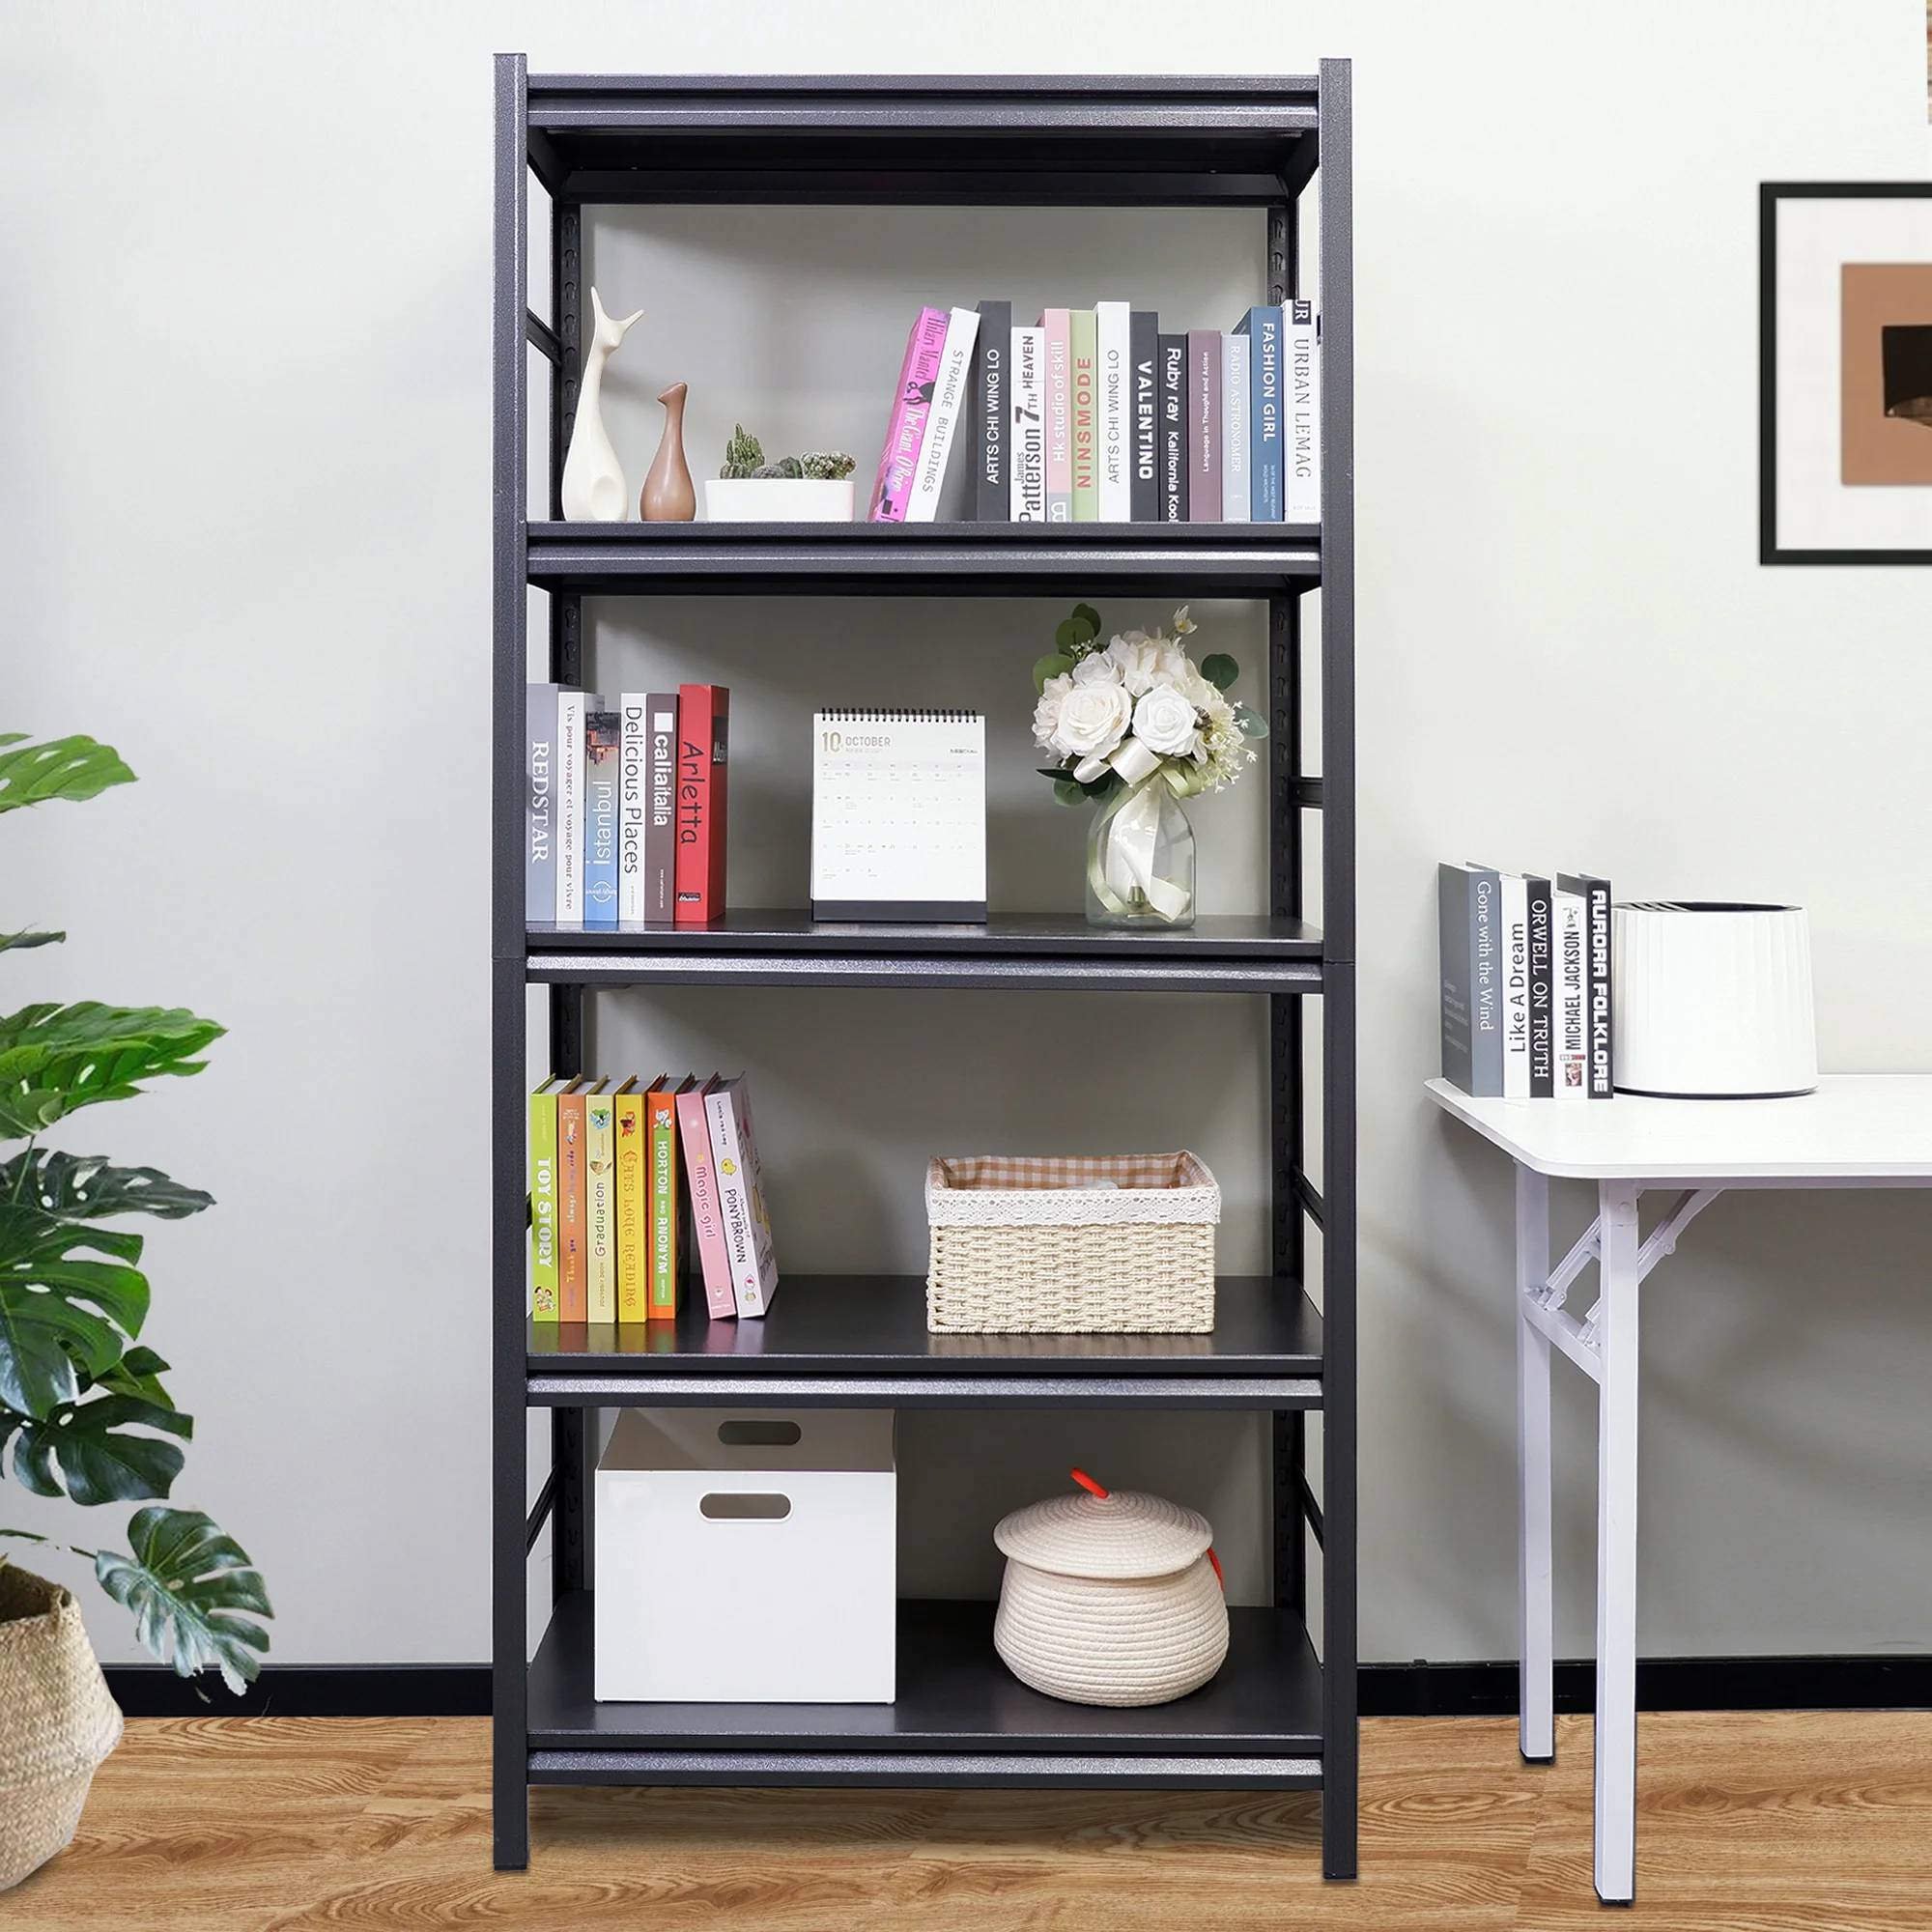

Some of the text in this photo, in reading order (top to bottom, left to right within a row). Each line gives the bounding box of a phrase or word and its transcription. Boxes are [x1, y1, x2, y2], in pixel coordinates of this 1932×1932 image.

[1021, 335, 1035, 389] HEAVEN
[1053, 341, 1065, 462] Hk studio of skill
[1165, 347, 1181, 392] Ruby
[1165, 395, 1179, 422] ray
[1201, 351, 1210, 472] Language in Thought and Action
[1230, 345, 1242, 472] RADIO ASTRONOMER
[1262, 322, 1276, 442] FASHION GIRL
[1293, 339, 1312, 479] URBAN LEMAG
[903, 407, 926, 425] The
[922, 349, 964, 494] STRANGE BUILDINGS
[985, 349, 1001, 485] ARTS CHI WING LO
[1076, 356, 1092, 489] NINSMODE
[1107, 349, 1121, 485] ARTS CHI WING LO
[1137, 360, 1153, 480] VALENTINO
[1167, 431, 1180, 492] Kalifornia
[1014, 451, 1025, 485] James
[1019, 428, 1041, 523] Patterson
[624, 706, 642, 874] Delicious Places
[653, 734, 674, 827] caliaitalia
[680, 741, 706, 844] Arletta
[821, 731, 892, 753] 10 OCTOBER
[531, 741, 550, 864] REDSTAR
[564, 704, 576, 910] Vis pour voyager et voyage pour vivre
[1477, 880, 1494, 1031] Gone with the Wind
[1509, 923, 1525, 1052] Like A Dream
[1531, 899, 1548, 1079] ORWELL ON TRUTH
[1564, 930, 1580, 990] JACKSON
[1592, 889, 1609, 1094] AURORA FOLKLORE
[1565, 993, 1581, 1050] MICHAEL
[537, 1158, 553, 1268] TOY STORY
[567, 1194, 577, 1224] always
[657, 1140, 668, 1195] HORTON
[695, 1165, 716, 1239] Magic girl
[566, 1254, 576, 1282] Thank
[594, 1181, 606, 1258] Graduation
[657, 1217, 668, 1274] ANONYM
[724, 1188, 747, 1264] PONYBROWN
